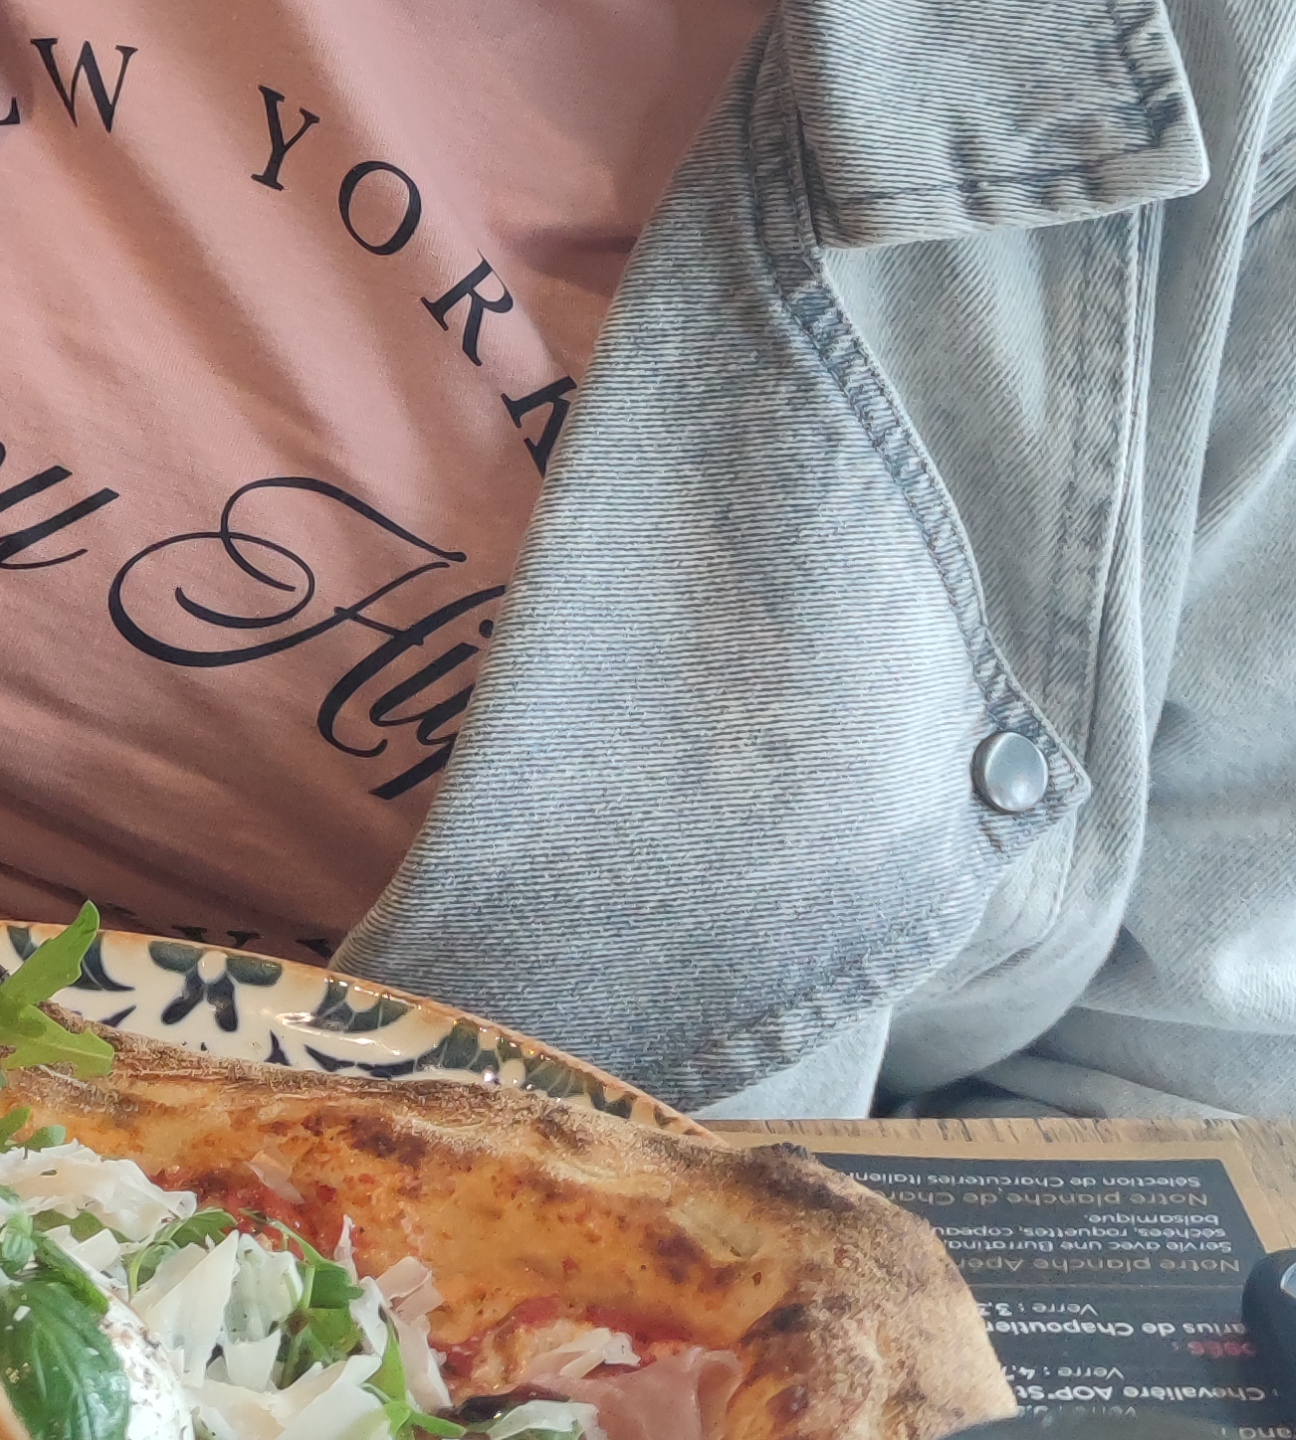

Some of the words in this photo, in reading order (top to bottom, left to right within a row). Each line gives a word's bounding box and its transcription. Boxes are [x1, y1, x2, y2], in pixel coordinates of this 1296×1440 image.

[847, 1172, 922, 1186] Italien
[927, 1174, 1065, 1188] Charcuteries
[1069, 1176, 1096, 1188] de
[962, 1191, 997, 1206] de
[1007, 1191, 1121, 1208] planche
[1129, 1192, 1208, 1207] Notre
[1059, 1240, 1103, 1251] une
[1107, 1240, 1161, 1251] avec
[1032, 1257, 1152, 1273] planche
[1159, 1258, 1240, 1273] Notre
[1032, 1303, 1099, 1316] Verre
[1141, 1321, 1175, 1337] de
[1182, 1322, 1247, 1336] arius
[1057, 1367, 1125, 1380] Verre
